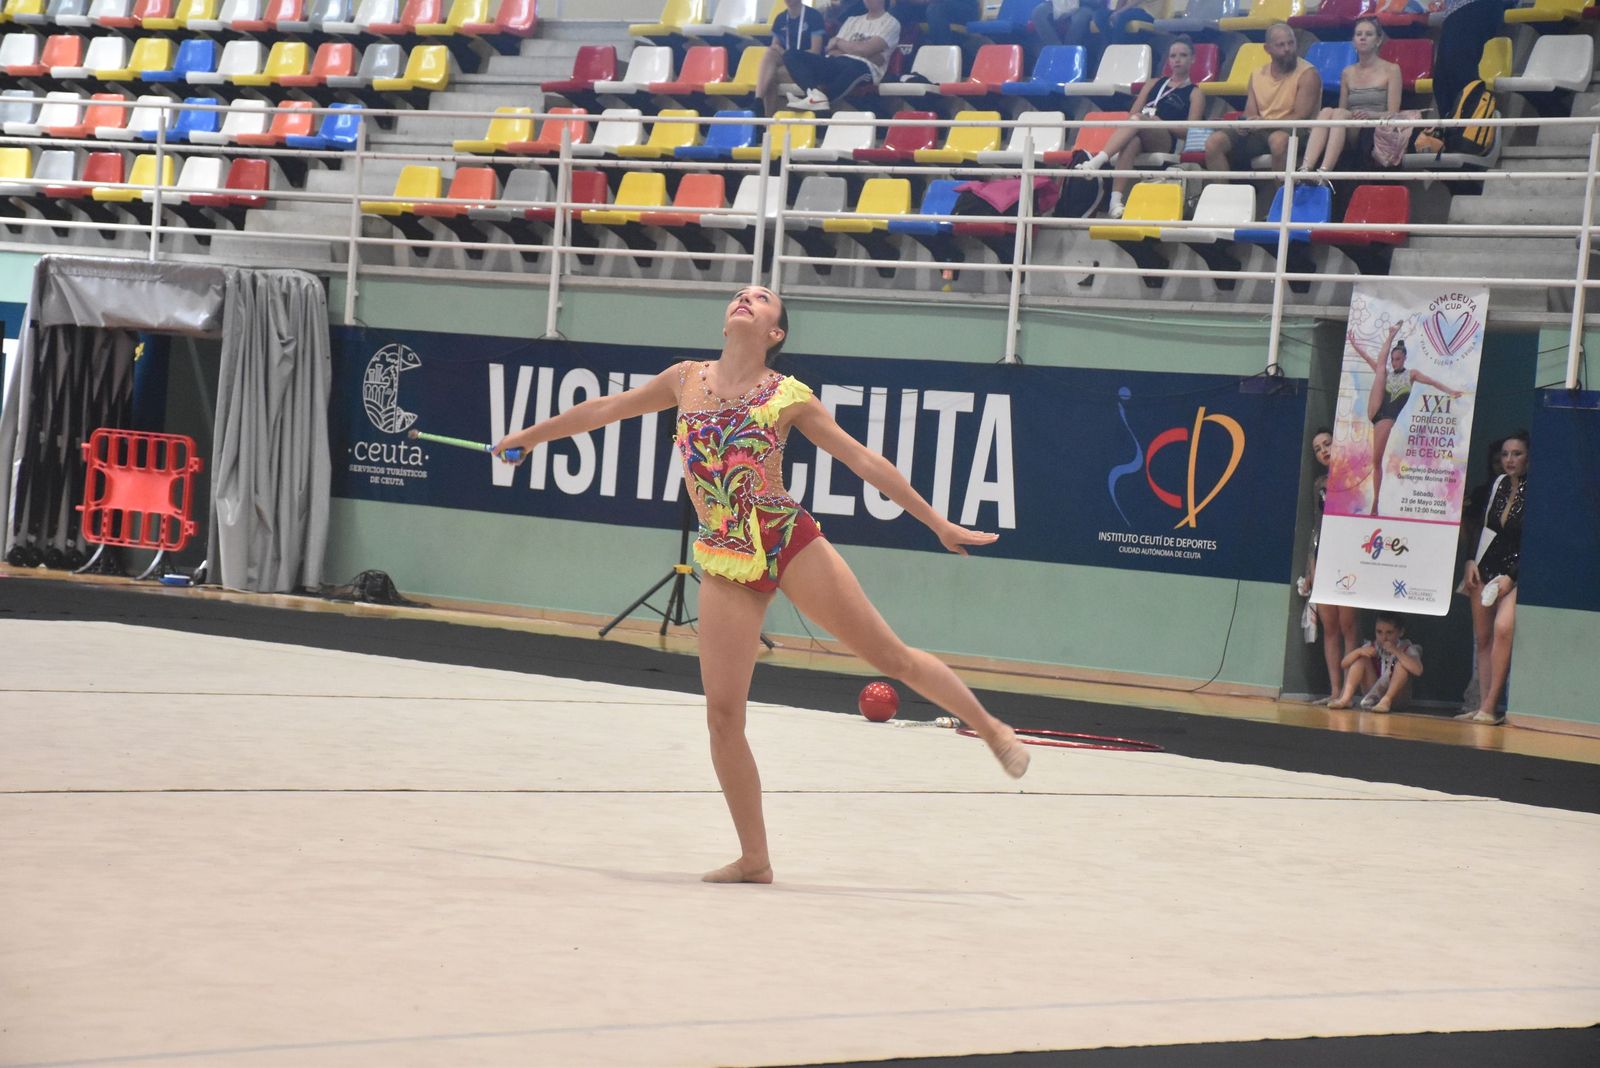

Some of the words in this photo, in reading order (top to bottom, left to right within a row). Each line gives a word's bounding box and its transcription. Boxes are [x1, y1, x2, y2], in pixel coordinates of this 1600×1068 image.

[1429, 294, 1448, 311] GYM
[1451, 293, 1476, 312] CEUTA
[1419, 395, 1451, 413] XXI
[1412, 415, 1444, 424] TORNEO
[1446, 417, 1457, 425] DE
[1409, 424, 1456, 436] GIMNASIA
[1419, 448, 1453, 459] CEUTA
[349, 464, 385, 475] SERVICIOS
[386, 466, 427, 478] TURÍSTICOS
[1401, 465, 1426, 474] Complejo
[1428, 468, 1455, 476] Deportivo
[380, 477, 404, 486] CEUTA
[1098, 531, 1138, 543] INSTITUTO
[1139, 535, 1162, 545] CEUTÍ
[1164, 537, 1175, 546] DE
[1176, 538, 1217, 550] DEPORTES
[1119, 546, 1140, 554] CIUDAD
[1141, 547, 1174, 557] AUTÓNOMA
